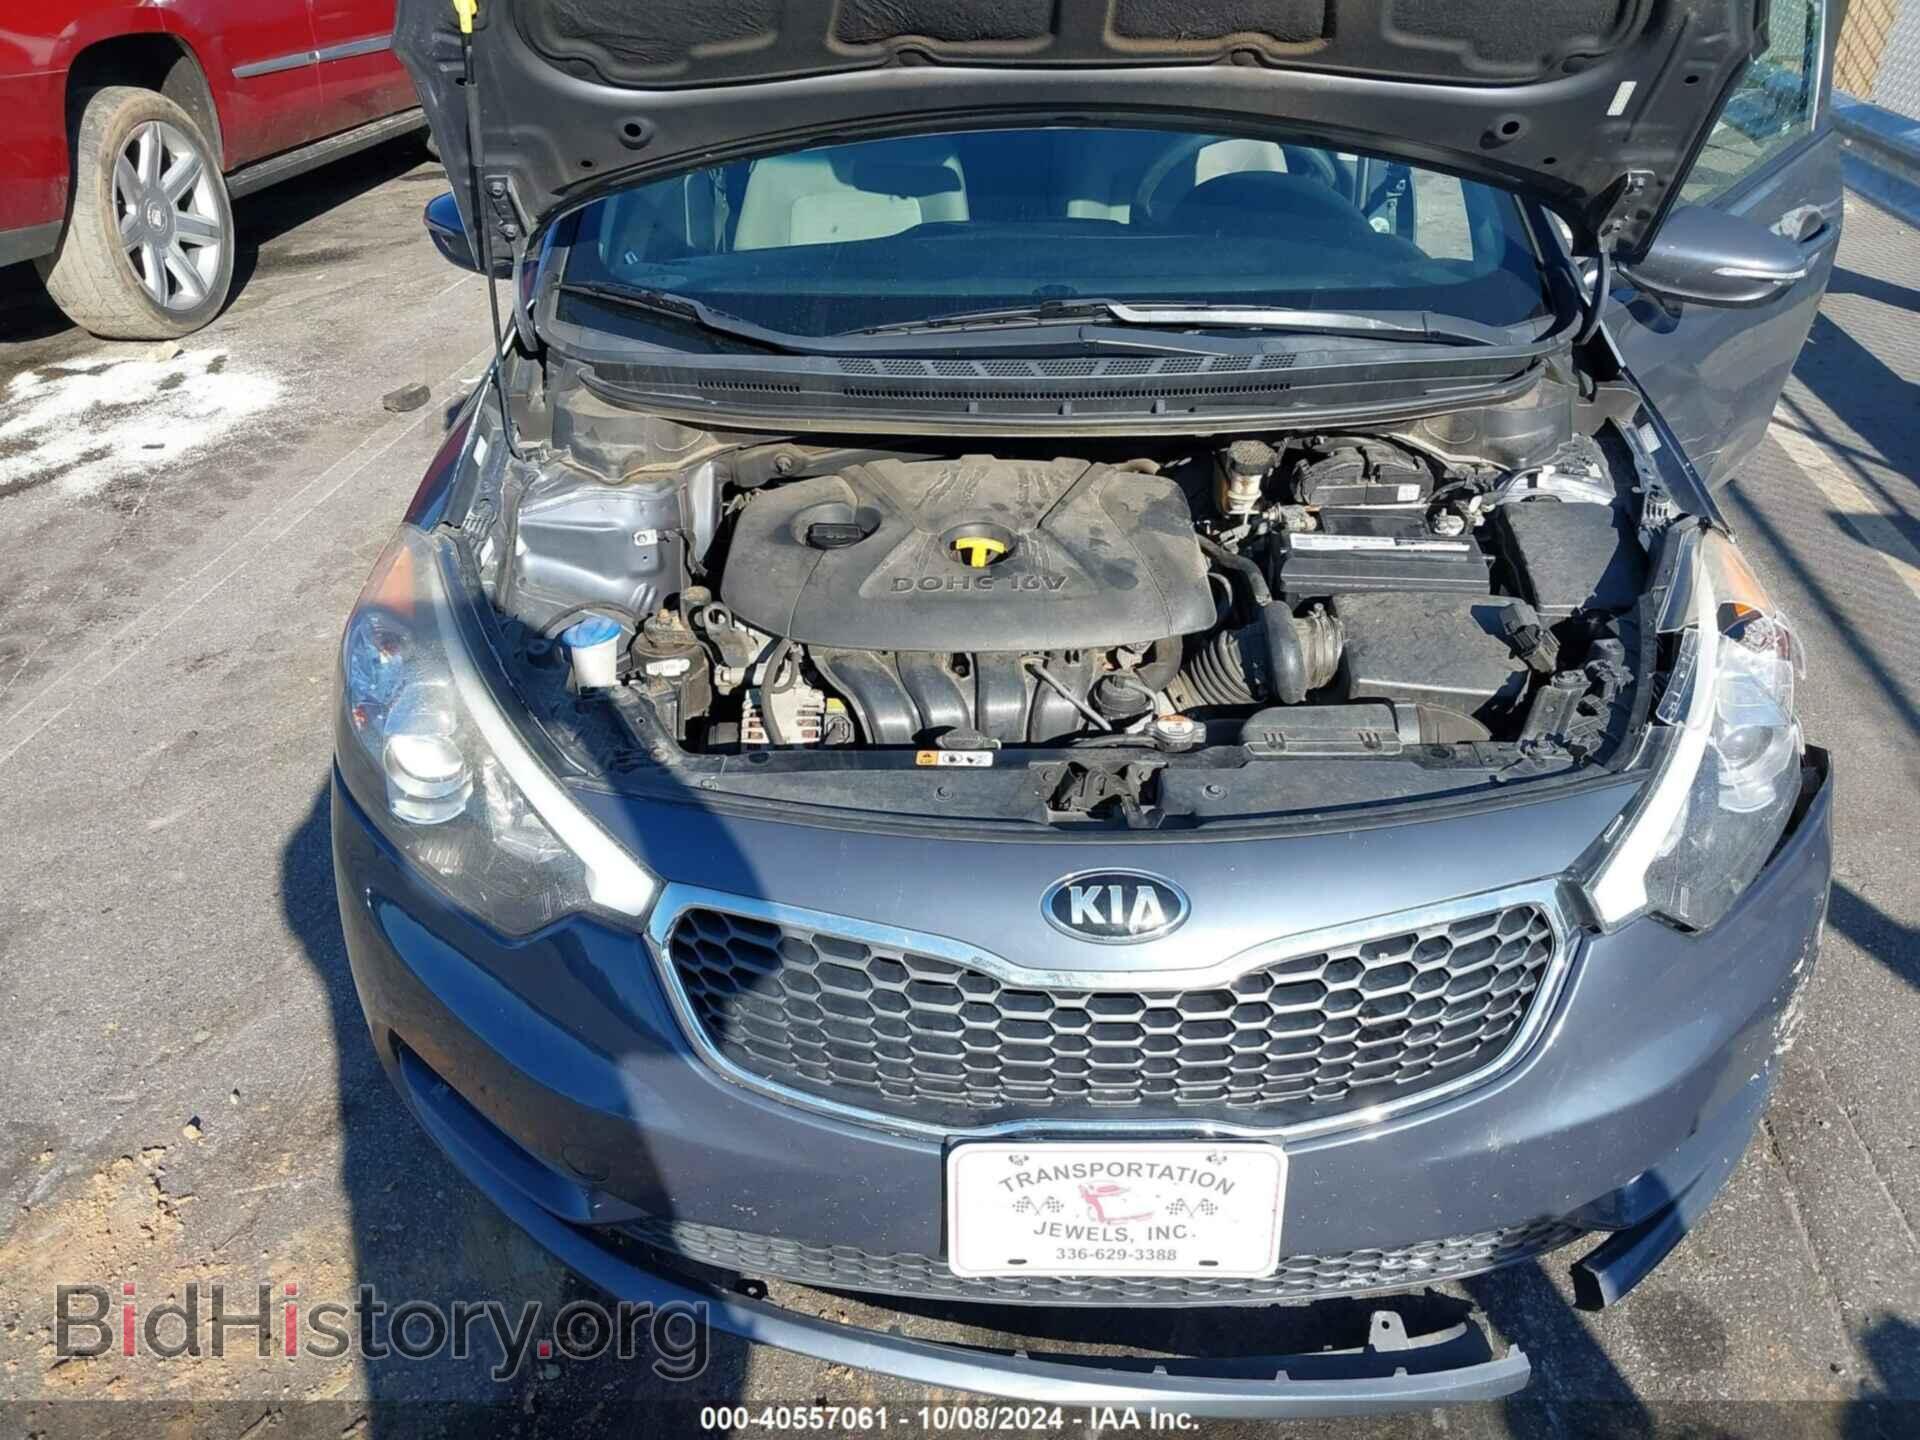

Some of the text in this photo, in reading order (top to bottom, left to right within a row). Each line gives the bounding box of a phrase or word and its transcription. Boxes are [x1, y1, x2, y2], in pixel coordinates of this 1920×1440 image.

[891, 575, 1068, 593] DOHC 16V
[1068, 884, 1167, 934] KIA
[999, 1161, 1236, 1196] TRANSPORTATION
[1033, 1221, 1197, 1244] JEWELS, INC.
[1056, 1247, 1178, 1262] 336-629-3388
